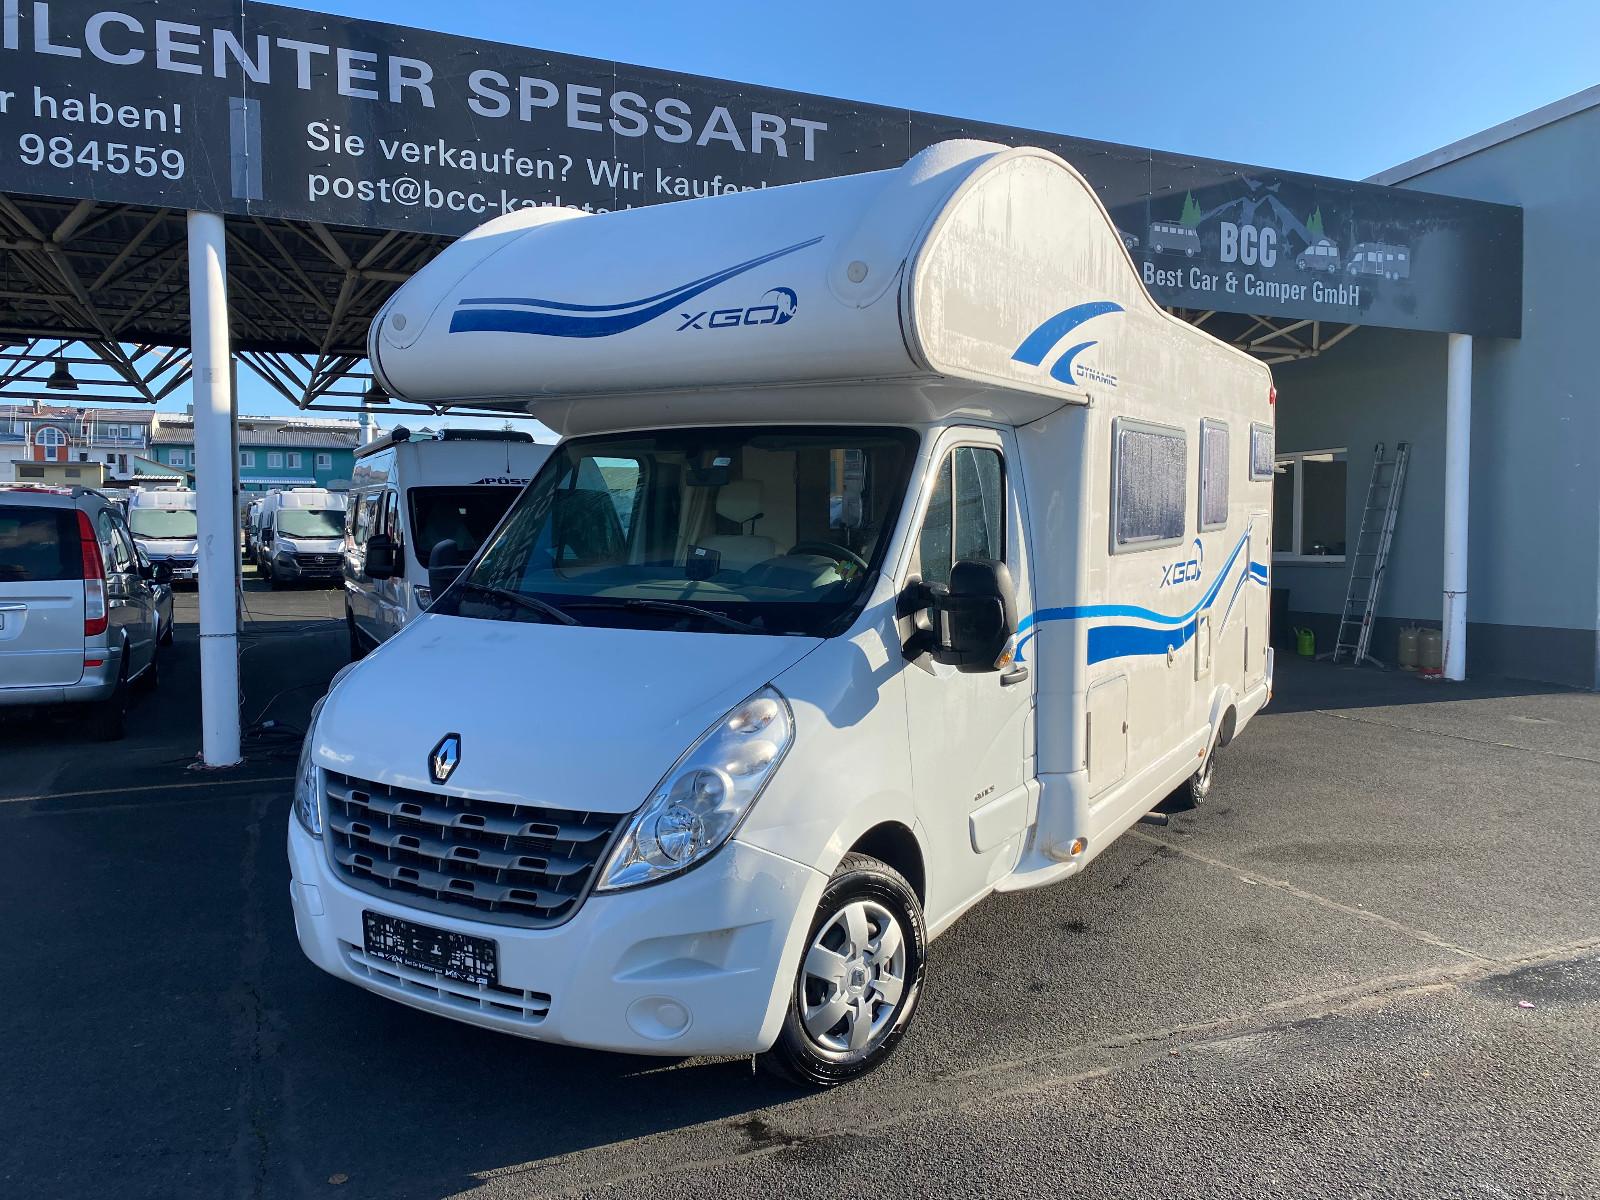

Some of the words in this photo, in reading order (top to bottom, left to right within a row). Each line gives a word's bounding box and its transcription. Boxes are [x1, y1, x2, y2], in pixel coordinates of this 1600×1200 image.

[3, 0, 436, 108] ILCENTER
[467, 70, 828, 162] SPESSART
[34, 86, 182, 134] haben!
[19, 133, 185, 180] 984559
[307, 121, 365, 157] Sie
[379, 138, 574, 183] verkaufen?
[587, 158, 644, 191] Wir
[1220, 221, 1278, 268] BCC
[1143, 261, 1183, 288] Best
[1189, 266, 1219, 292] Car
[1225, 271, 1239, 293] &
[1244, 273, 1307, 302] Camper
[1312, 281, 1360, 306] GmbH
[675, 304, 780, 332] XGO
[1076, 364, 1118, 388] DYNAMIC
[1160, 559, 1199, 589] XGO
